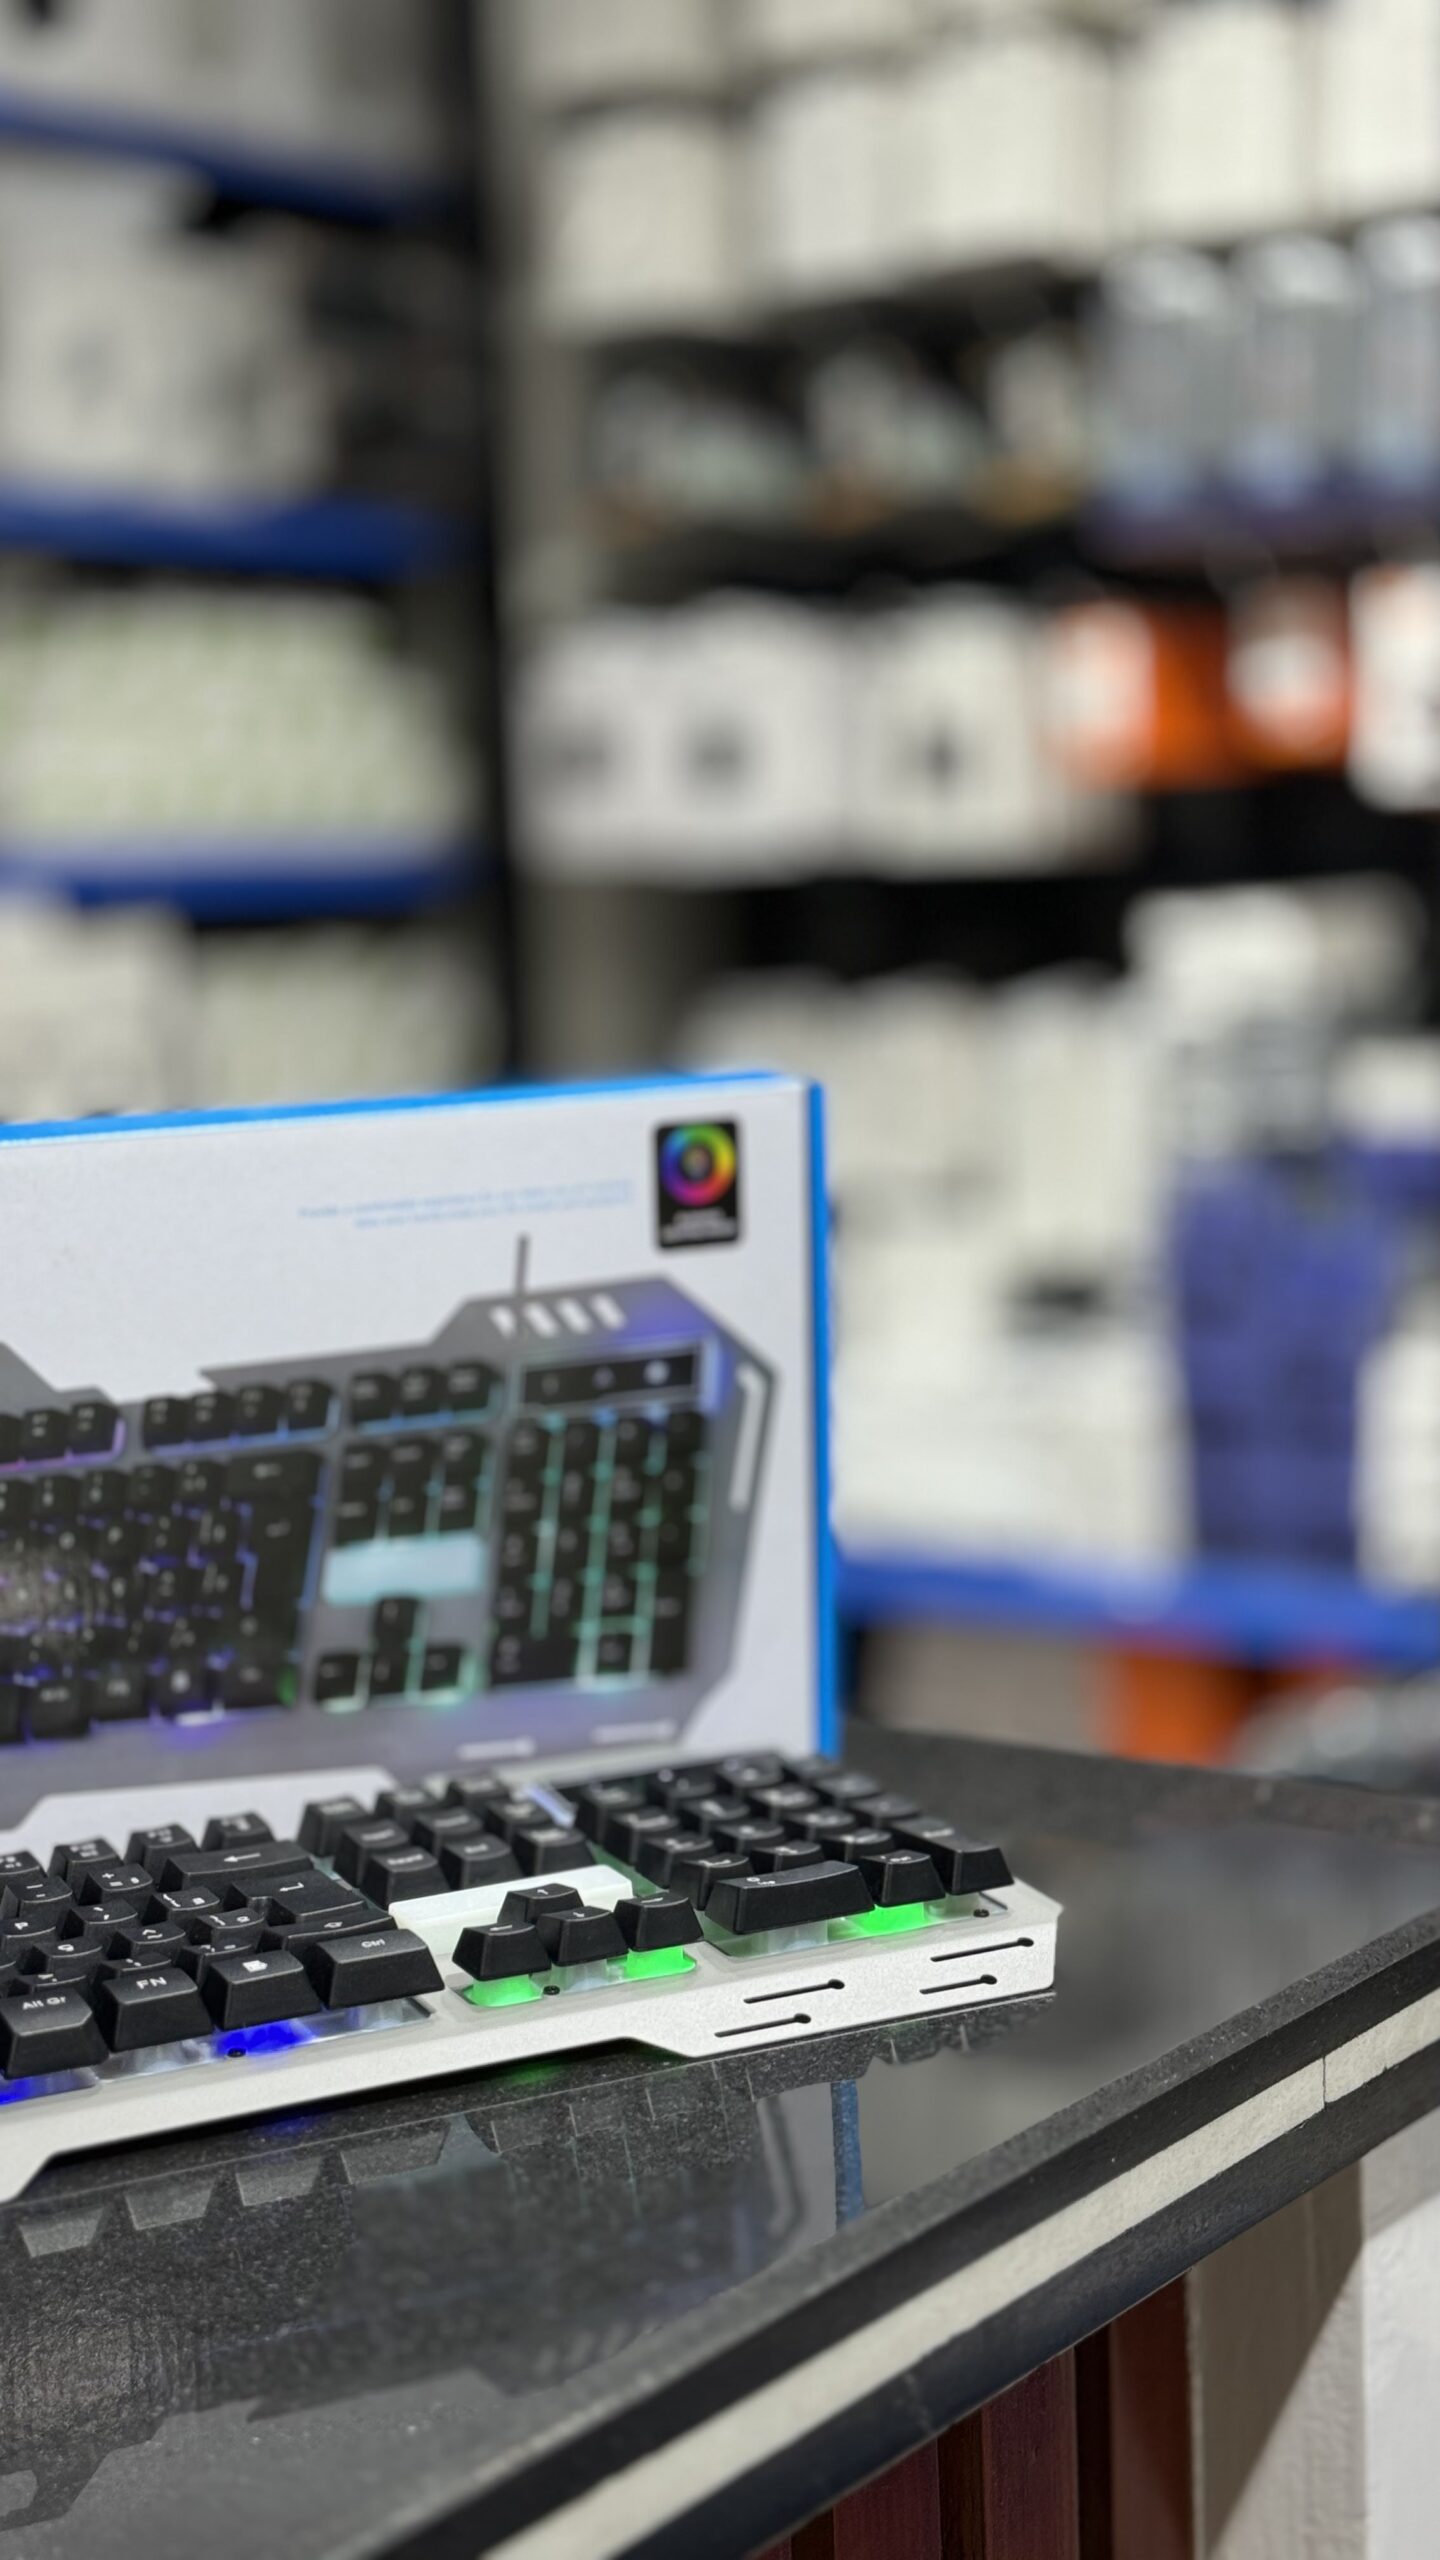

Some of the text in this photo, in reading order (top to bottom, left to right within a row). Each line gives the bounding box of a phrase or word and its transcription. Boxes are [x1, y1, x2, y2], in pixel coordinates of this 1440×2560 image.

[361, 1938, 386, 1949] Ctrl
[136, 1976, 167, 1989] FN
[22, 1996, 66, 2010] Alt Gr
